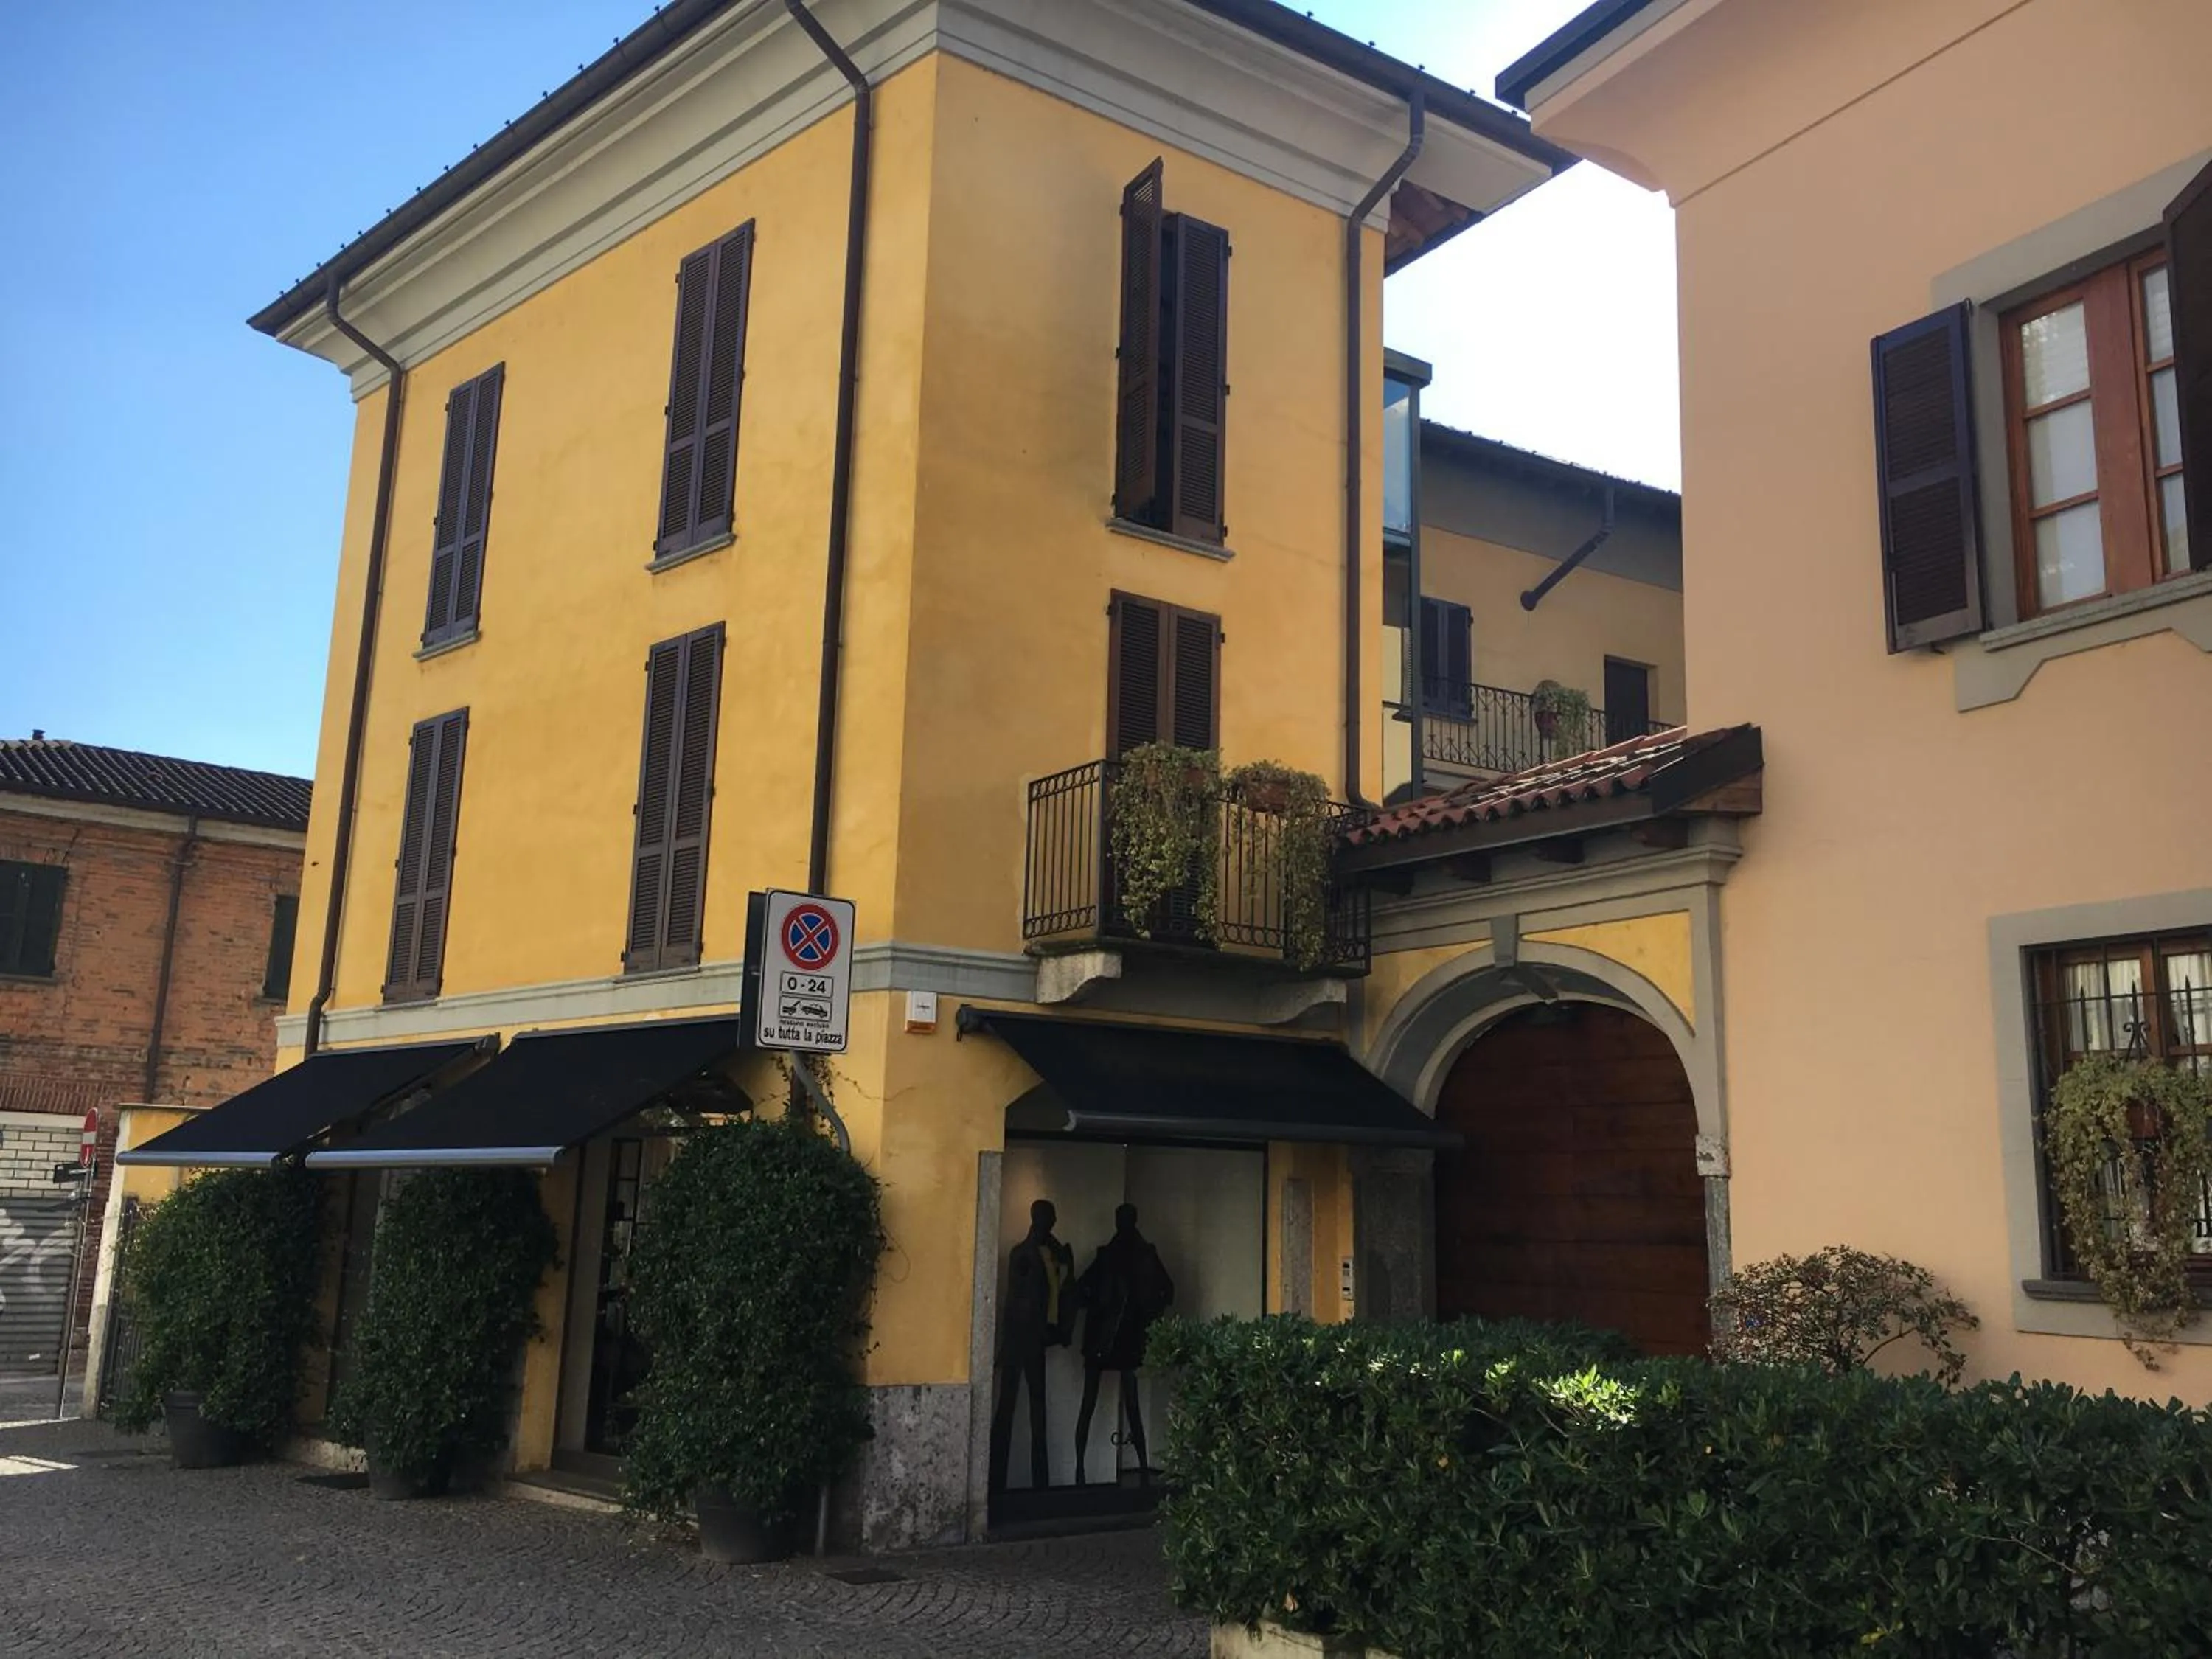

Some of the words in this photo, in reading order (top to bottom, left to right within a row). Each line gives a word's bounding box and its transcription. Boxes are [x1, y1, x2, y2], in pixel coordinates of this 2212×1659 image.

[764, 1027, 774, 1038] su
[779, 1026, 800, 1040] tutta
[804, 1028, 812, 1041] la
[815, 1029, 843, 1044] piazza
